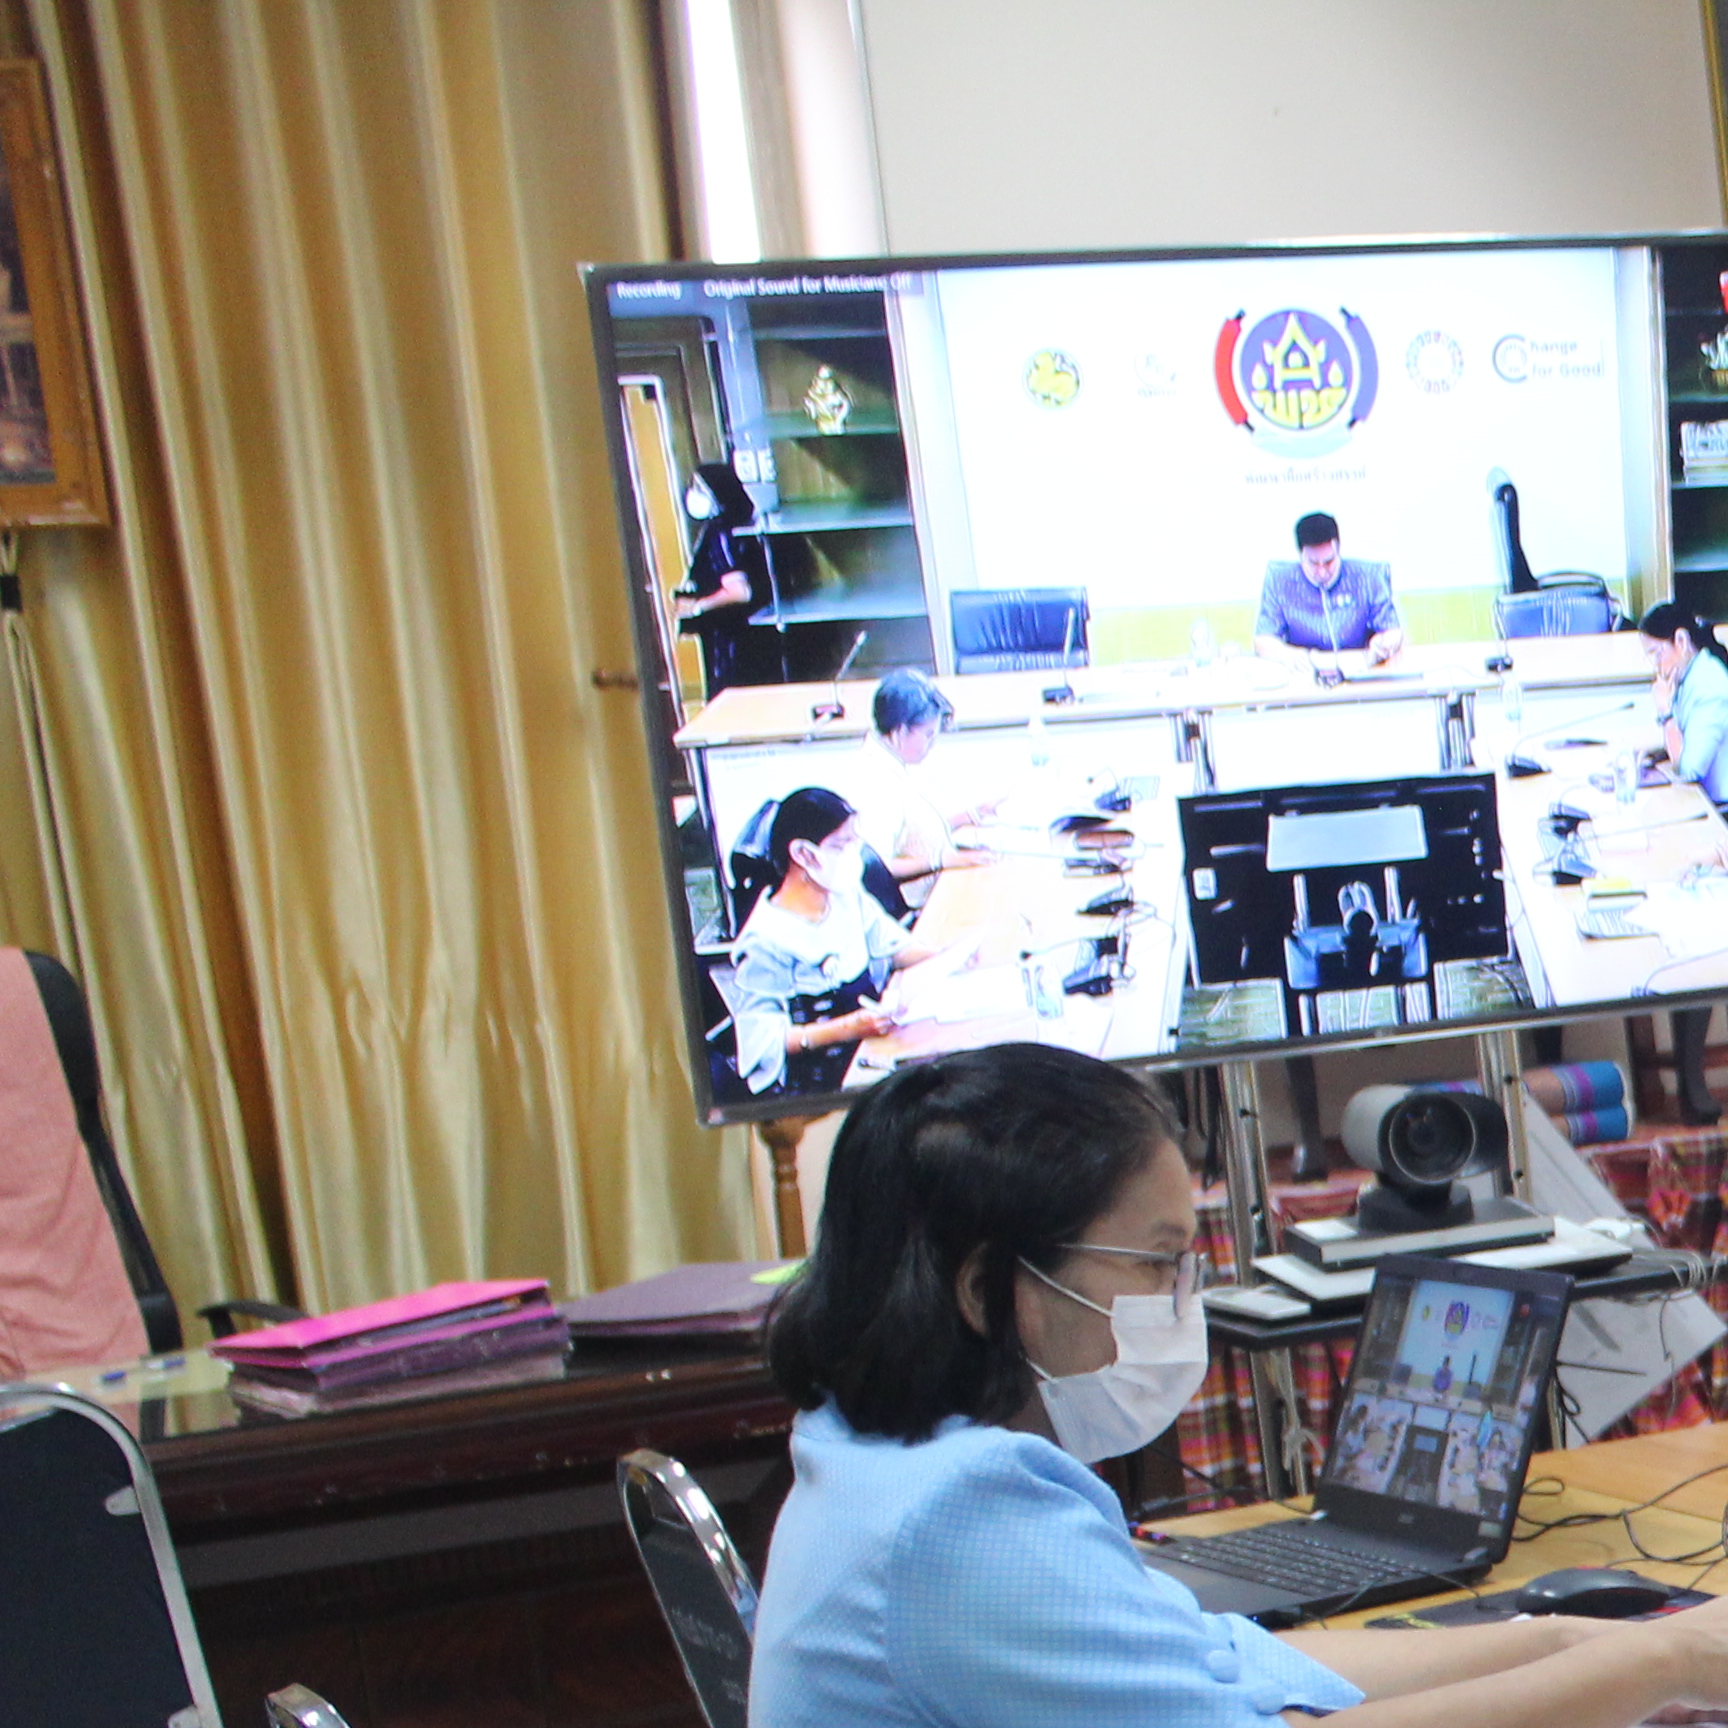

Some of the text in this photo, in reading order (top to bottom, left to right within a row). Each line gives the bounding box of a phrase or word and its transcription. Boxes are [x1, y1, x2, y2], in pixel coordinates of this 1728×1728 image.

[617, 281, 682, 300] Recording
[703, 277, 756, 299] Original
[758, 276, 799, 295] Sound
[801, 275, 823, 293] for
